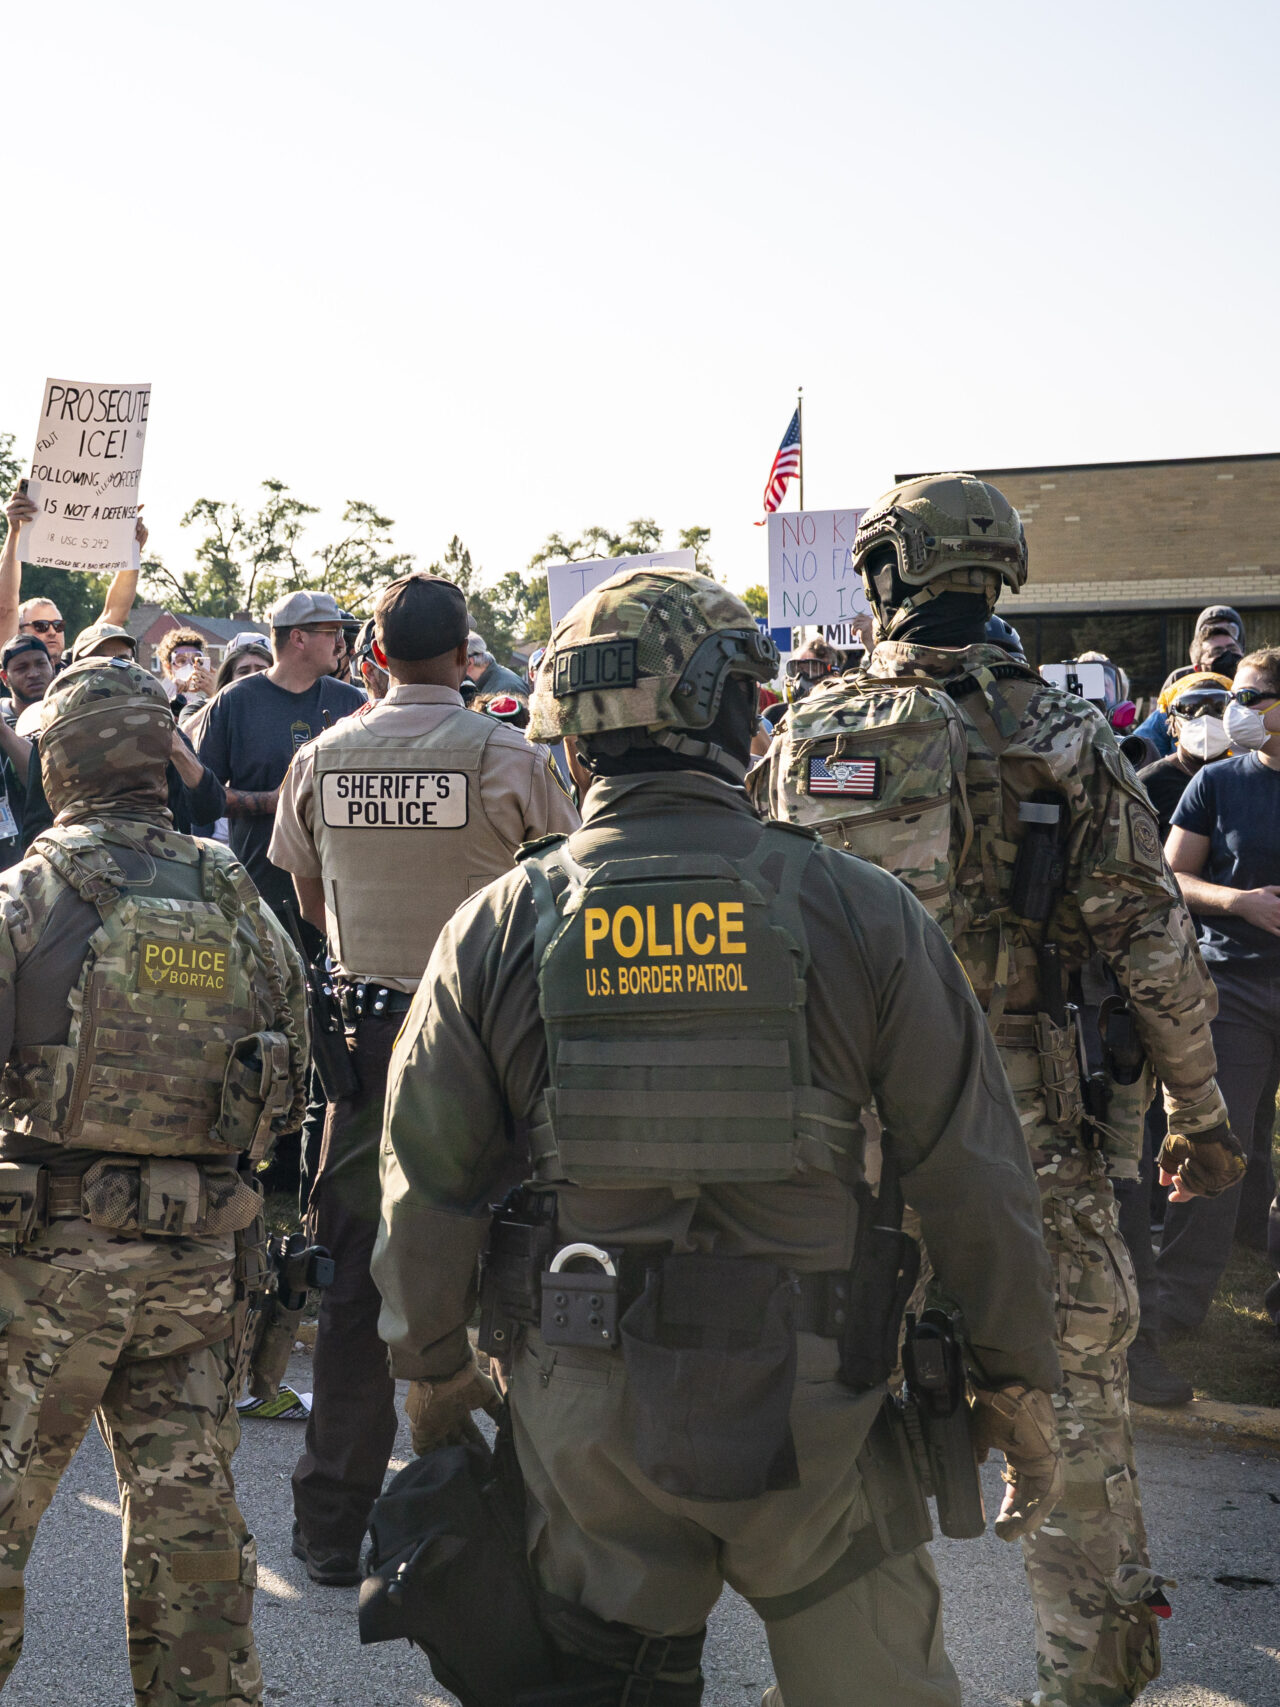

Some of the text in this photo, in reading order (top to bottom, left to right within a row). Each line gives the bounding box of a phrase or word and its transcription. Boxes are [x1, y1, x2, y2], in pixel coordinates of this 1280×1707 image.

[46, 385, 150, 423] PROSECUTE
[78, 429, 127, 459] ICE!
[30, 464, 100, 487] FOLLOWING
[44, 498, 58, 514] IS
[64, 503, 91, 518] NOT
[91, 506, 100, 520] A
[60, 535, 78, 546] USC
[782, 515, 816, 548] NO
[782, 551, 818, 583] NO
[783, 590, 818, 618] NO
[556, 647, 632, 693] POLICE
[337, 775, 450, 799] SHERIFF'S
[348, 801, 438, 825] POLICE
[584, 902, 747, 960] POLICE
[145, 944, 226, 972] POLICE
[169, 971, 225, 989] BORTAC
[586, 963, 748, 997] U.S. BORDER PATROL
